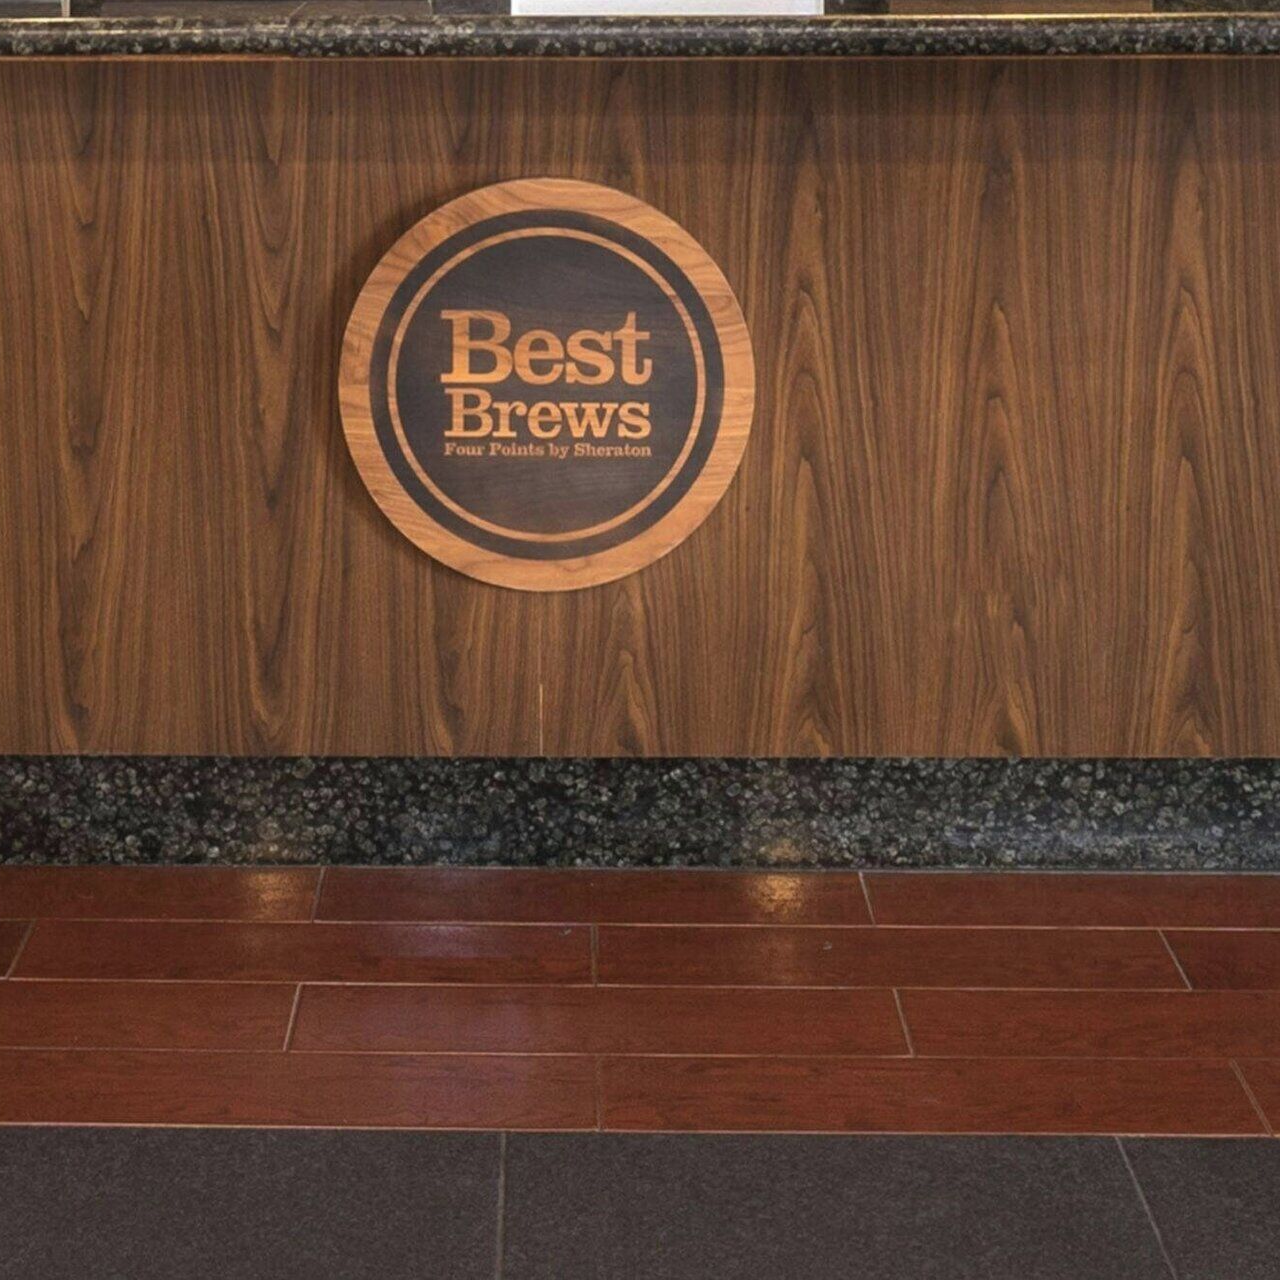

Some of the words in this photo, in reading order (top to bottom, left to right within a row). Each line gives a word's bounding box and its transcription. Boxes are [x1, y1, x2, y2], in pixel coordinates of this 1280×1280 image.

[440, 309, 653, 386] Best
[444, 388, 652, 439] Brews
[443, 442, 484, 456] Four
[490, 442, 545, 456] Points
[549, 442, 570, 459] by
[574, 442, 653, 457] Sheraton
